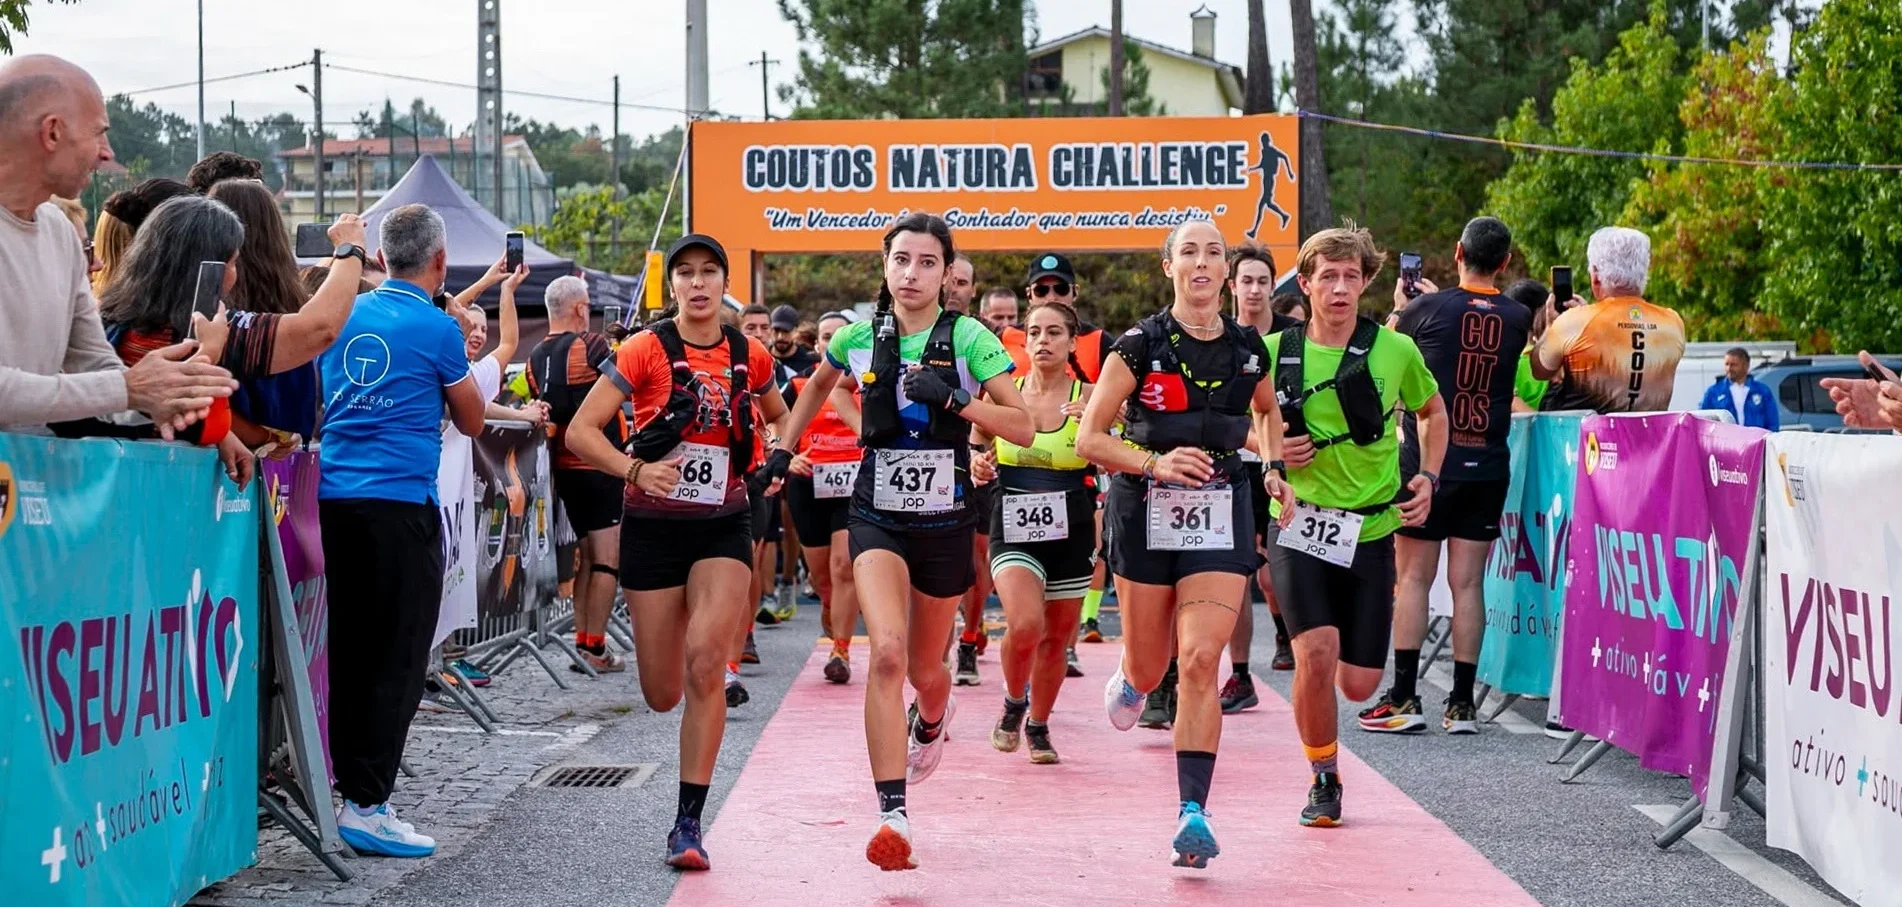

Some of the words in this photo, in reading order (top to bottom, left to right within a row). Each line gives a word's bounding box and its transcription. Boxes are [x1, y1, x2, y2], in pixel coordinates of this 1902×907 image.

[745, 147, 874, 189] COUTOS
[891, 147, 1036, 189] NATURA
[1052, 144, 1246, 187] CHALLENGE
[766, 209, 801, 228] "Um
[808, 210, 892, 229] Vencedor
[944, 210, 1034, 229] Sonhador
[1039, 213, 1071, 231] que
[1076, 211, 1130, 227] nunca
[350, 393, 394, 408] SERRÃO
[676, 460, 713, 485] 68
[824, 471, 851, 486] 467
[889, 467, 937, 492] 437
[676, 487, 699, 500] jop
[901, 497, 925, 509] jop
[1155, 491, 1171, 499] jop
[1016, 506, 1054, 528] 348
[1170, 506, 1211, 530] 361
[1027, 530, 1046, 540] jop
[1180, 535, 1204, 547] jop
[1300, 516, 1341, 546] 312
[1304, 543, 1327, 556] jop
[1780, 572, 1892, 718] VISEU
[134, 587, 244, 738] ATIVO
[1606, 637, 1638, 679] ativo
[1792, 728, 1847, 786] ativo
[109, 756, 191, 844] saudável
